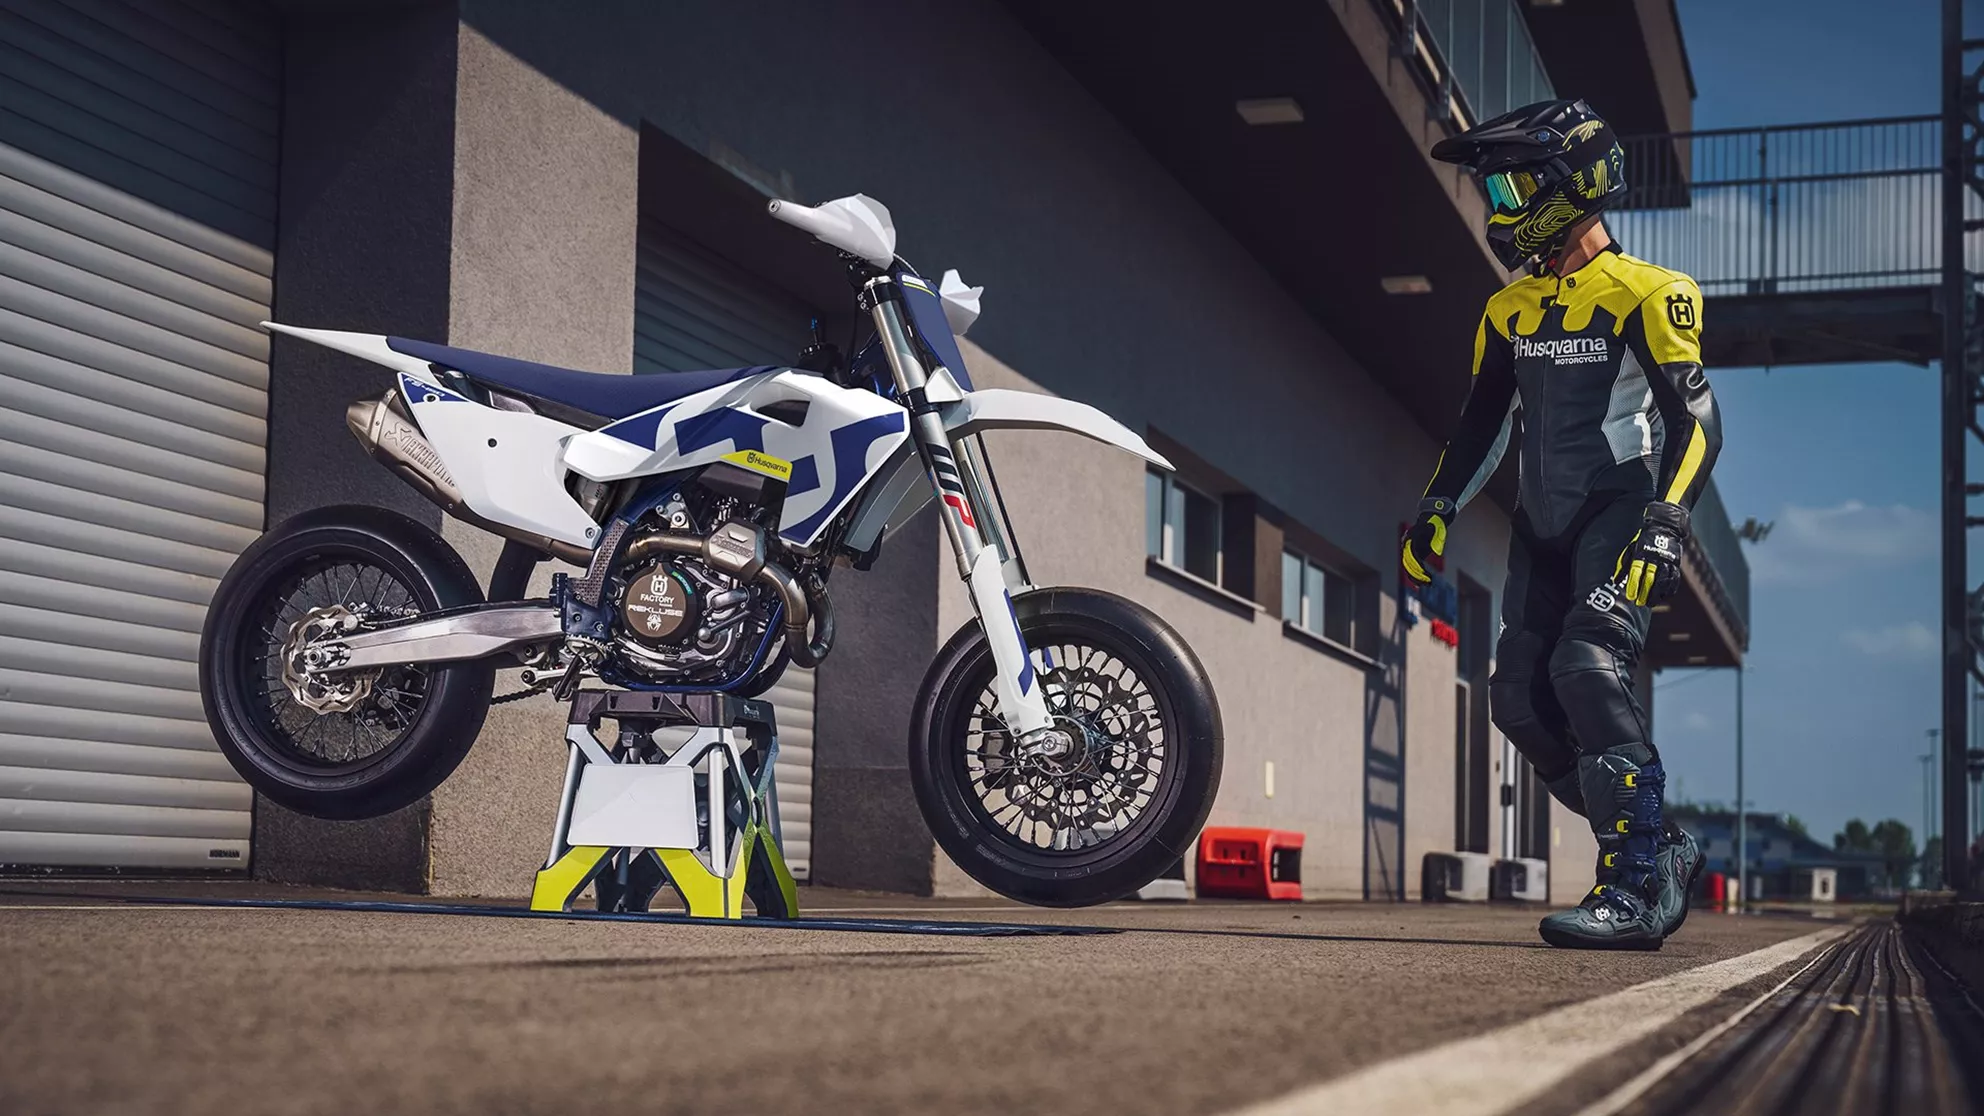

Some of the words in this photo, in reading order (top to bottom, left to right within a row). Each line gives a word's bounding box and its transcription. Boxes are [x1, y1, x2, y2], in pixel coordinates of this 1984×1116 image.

[1519, 336, 1607, 358] Husqvarna
[1554, 354, 1608, 365] MOTORCYCLES
[754, 457, 788, 473] Husqvarna
[640, 593, 674, 604] FACTORY
